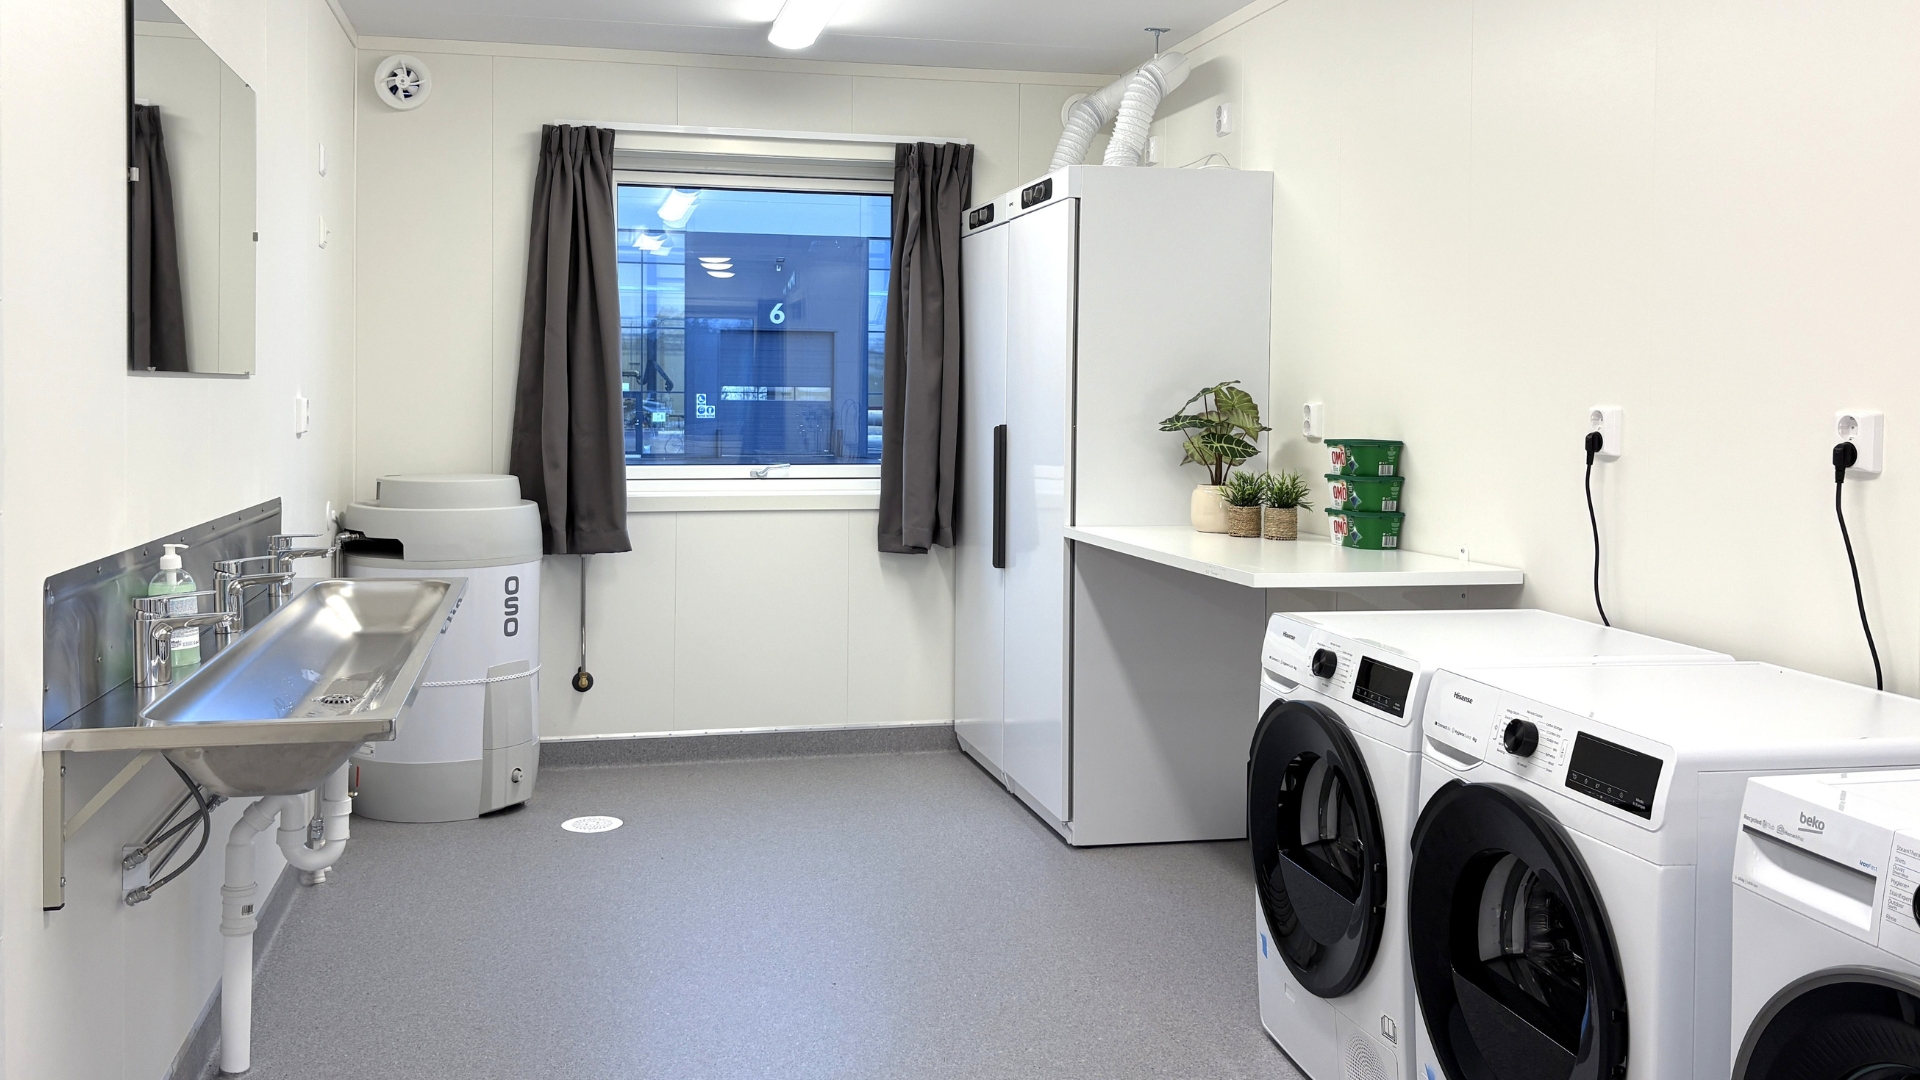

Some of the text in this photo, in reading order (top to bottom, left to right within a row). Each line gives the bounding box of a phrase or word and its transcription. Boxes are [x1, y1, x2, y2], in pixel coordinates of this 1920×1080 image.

[769, 303, 785, 324] 6
[1332, 451, 1346, 466] OMO
[1333, 485, 1348, 501] OMO
[1334, 520, 1348, 536] OMO
[503, 575, 520, 637] OSO
[1454, 692, 1473, 704] Hisense
[1799, 811, 1825, 831] beko
